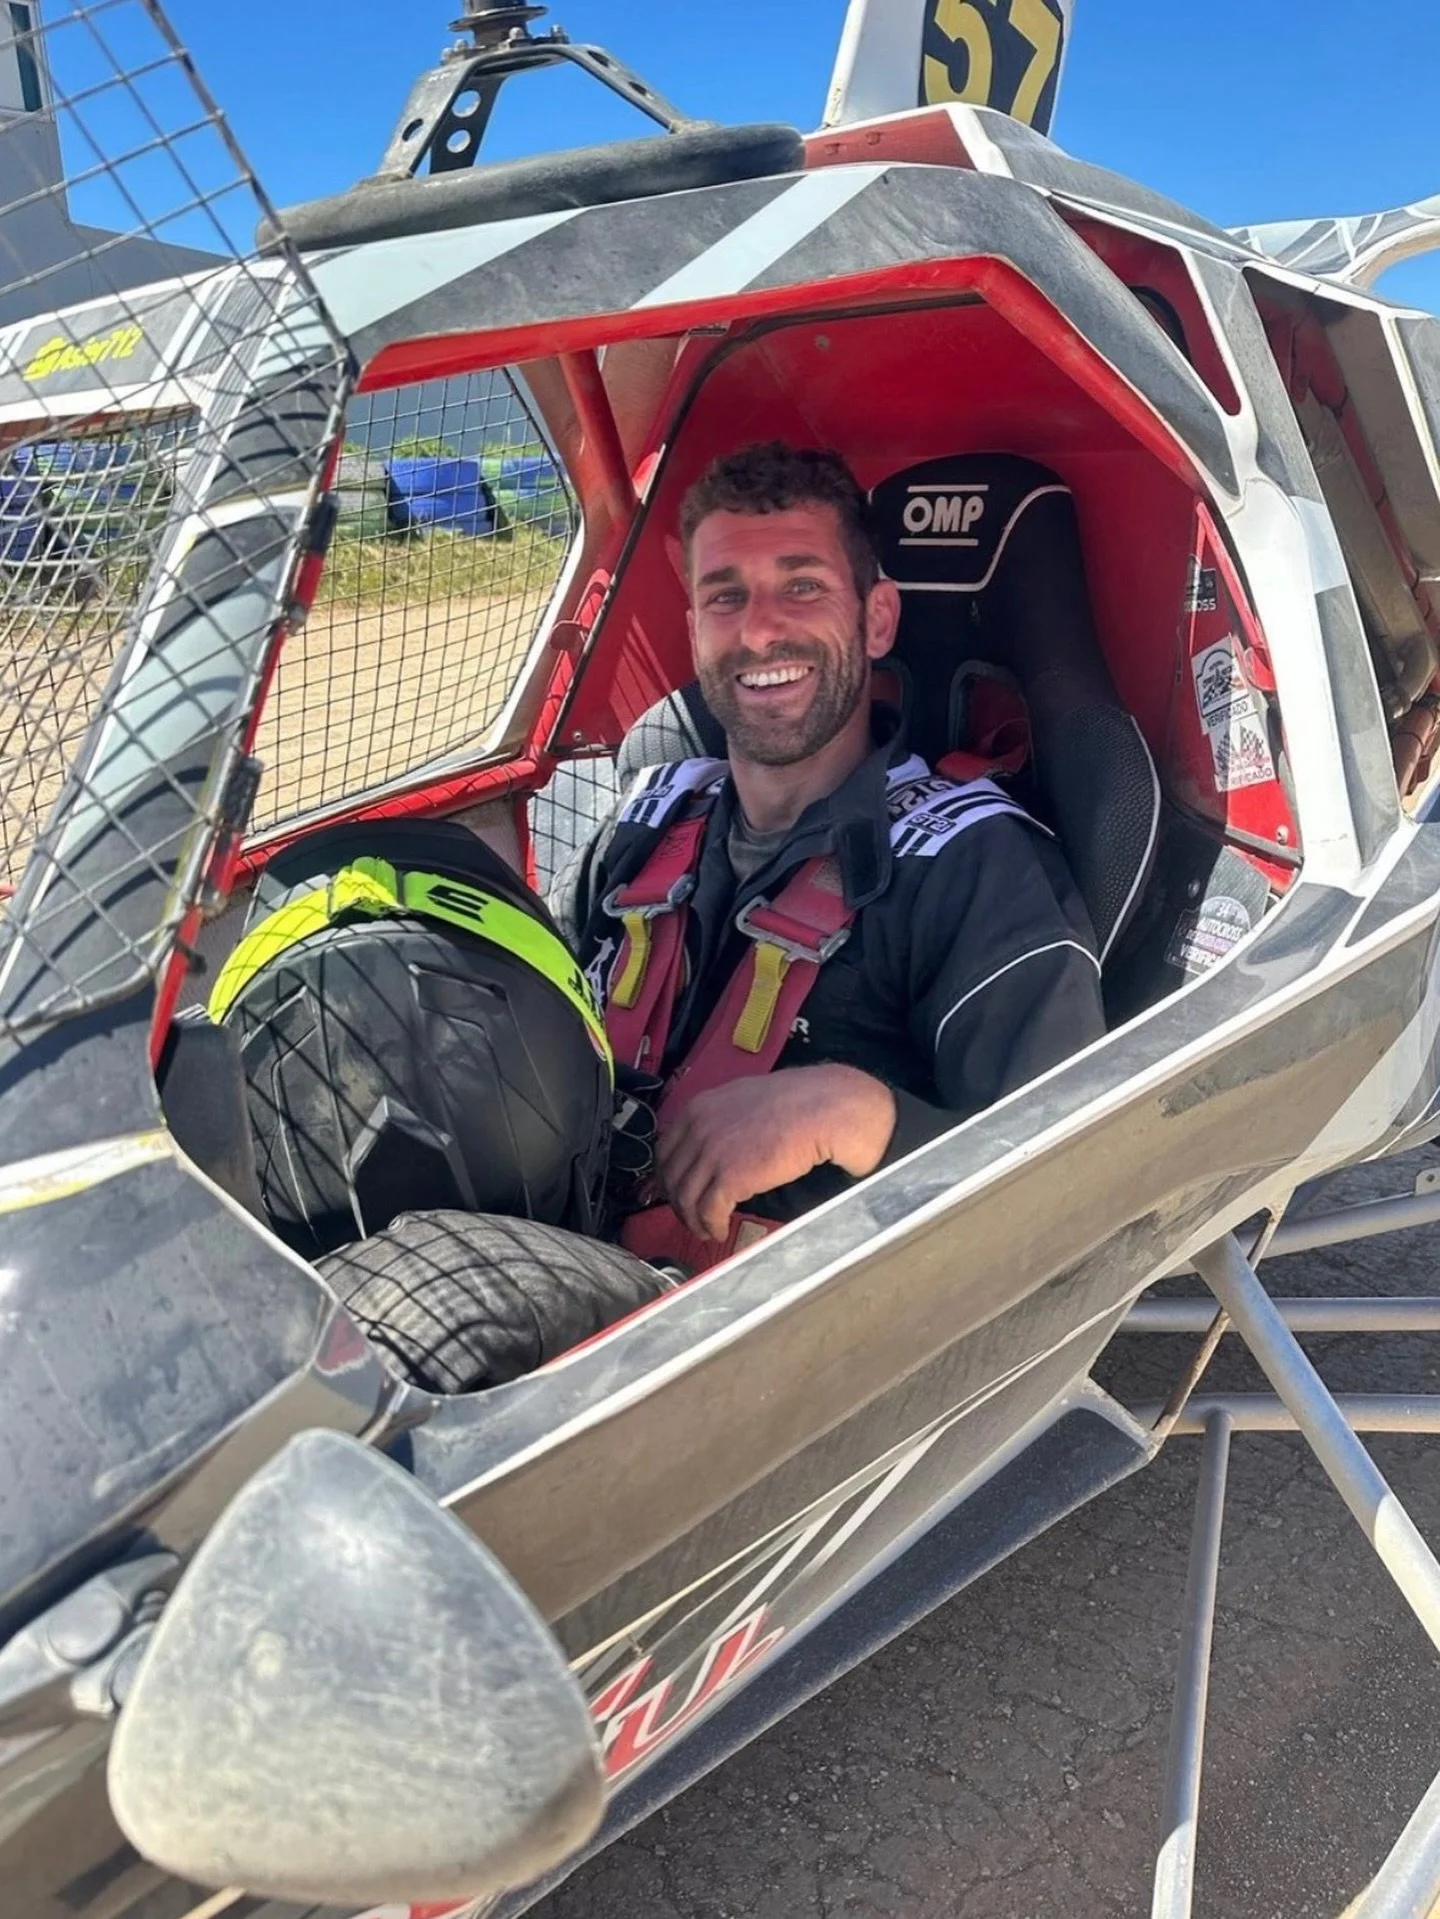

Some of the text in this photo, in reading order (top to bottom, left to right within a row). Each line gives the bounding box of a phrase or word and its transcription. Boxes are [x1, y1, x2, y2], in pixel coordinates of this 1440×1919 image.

[924, 0, 1061, 126] 57
[903, 495, 984, 532] OMP
[1205, 700, 1249, 729] VERIFICADO
